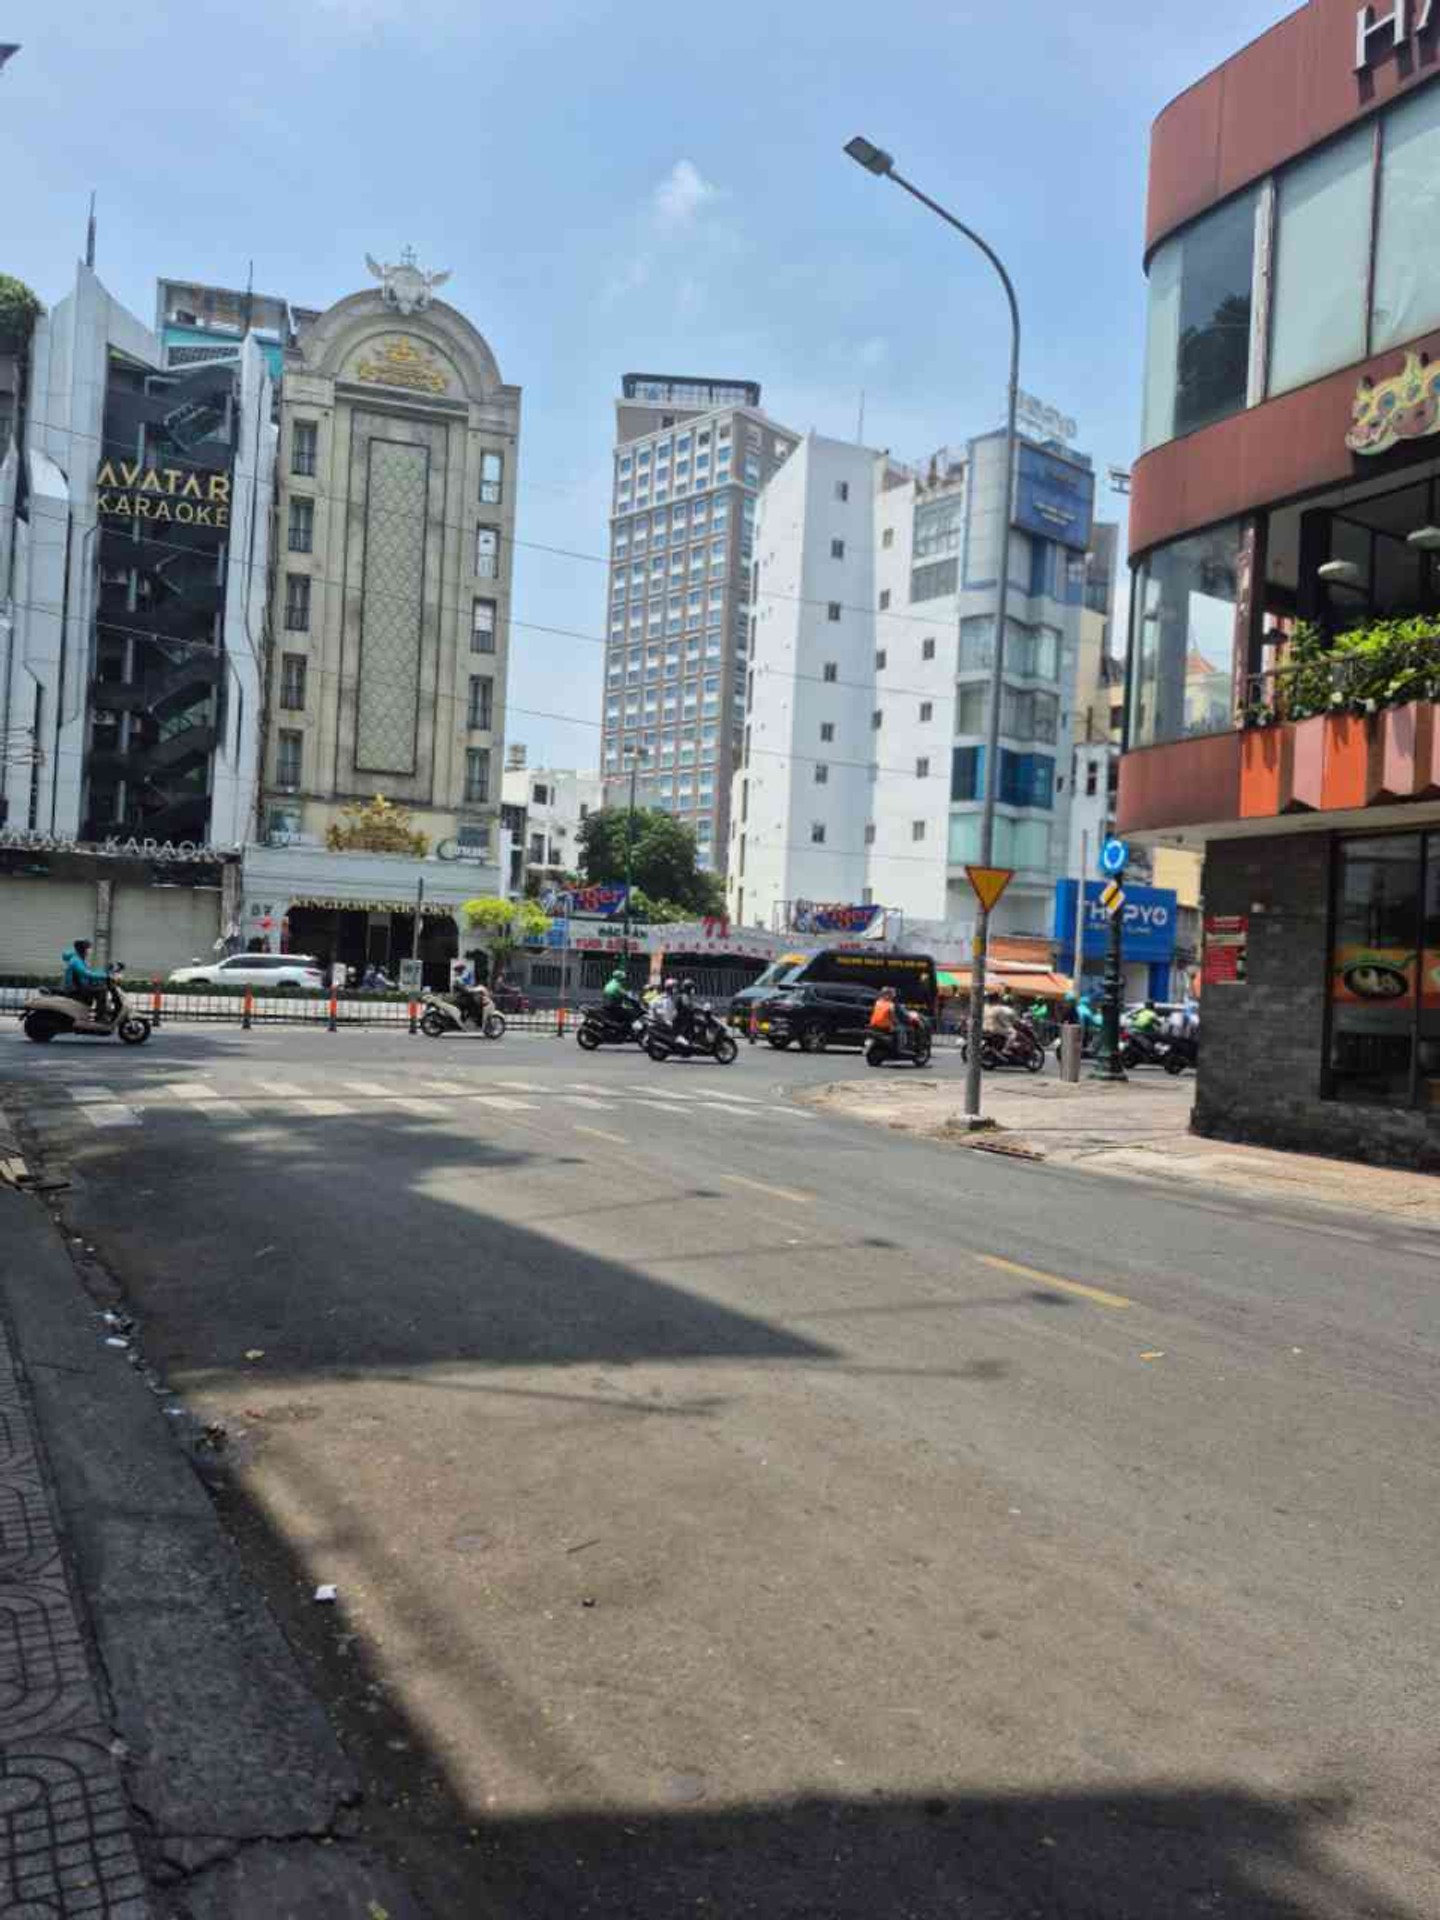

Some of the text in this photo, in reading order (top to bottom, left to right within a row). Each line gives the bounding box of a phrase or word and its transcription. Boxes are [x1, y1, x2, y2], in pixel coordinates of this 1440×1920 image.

[1356, 0, 1440, 68] H
[97, 459, 231, 504] AVATAR
[96, 491, 229, 529] KARAOKE
